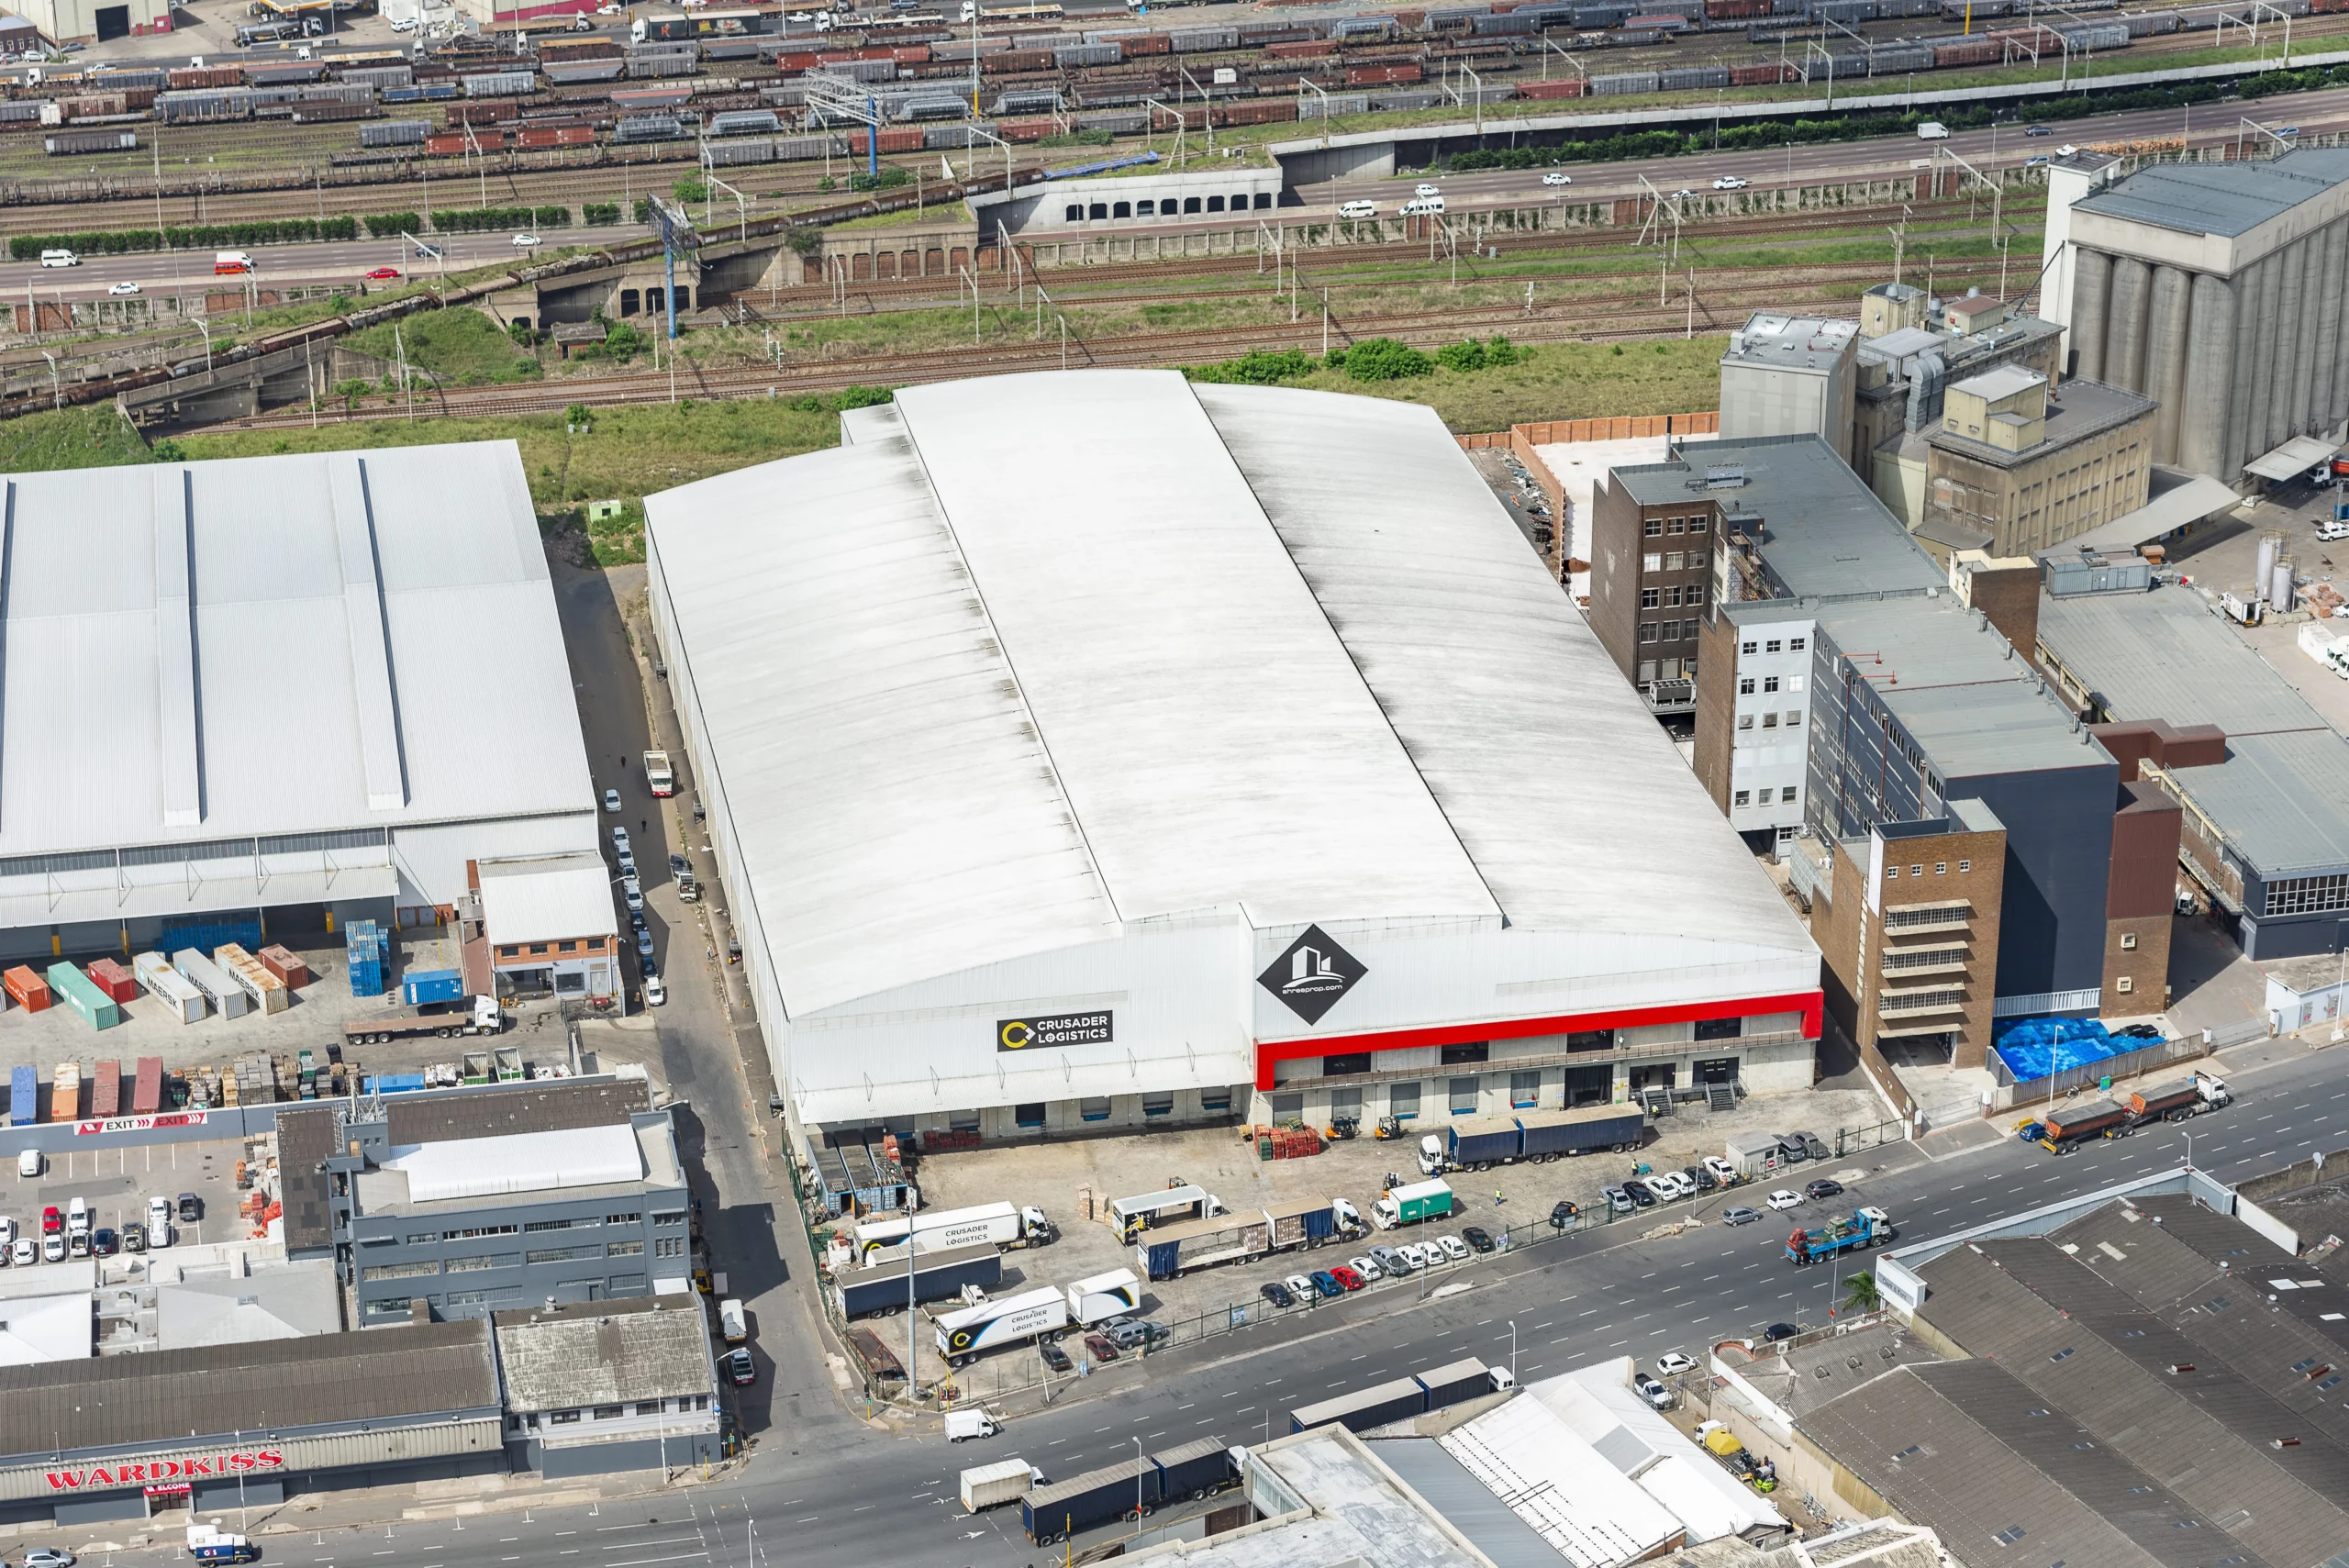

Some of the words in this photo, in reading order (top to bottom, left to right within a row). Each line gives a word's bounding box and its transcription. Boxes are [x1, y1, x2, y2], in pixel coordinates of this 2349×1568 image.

[187, 973, 219, 1006] MAERSK
[228, 968, 260, 1001] MAERSK
[147, 976, 178, 1010] MAERSK
[1037, 1016, 1108, 1030] CRUSADER
[1038, 1028, 1108, 1043] LOGISTICS
[106, 1119, 135, 1130] EXIT
[157, 1115, 185, 1126] EXIT
[945, 1224, 988, 1237] CRUSADER
[946, 1233, 988, 1246] LOGISTICS
[1011, 1309, 1047, 1323] CRUSADER
[1012, 1318, 1048, 1332] LOGISICS
[44, 1448, 284, 1491] WARDKISS
[1275, 1480, 1304, 1509] INTERNATIONA
